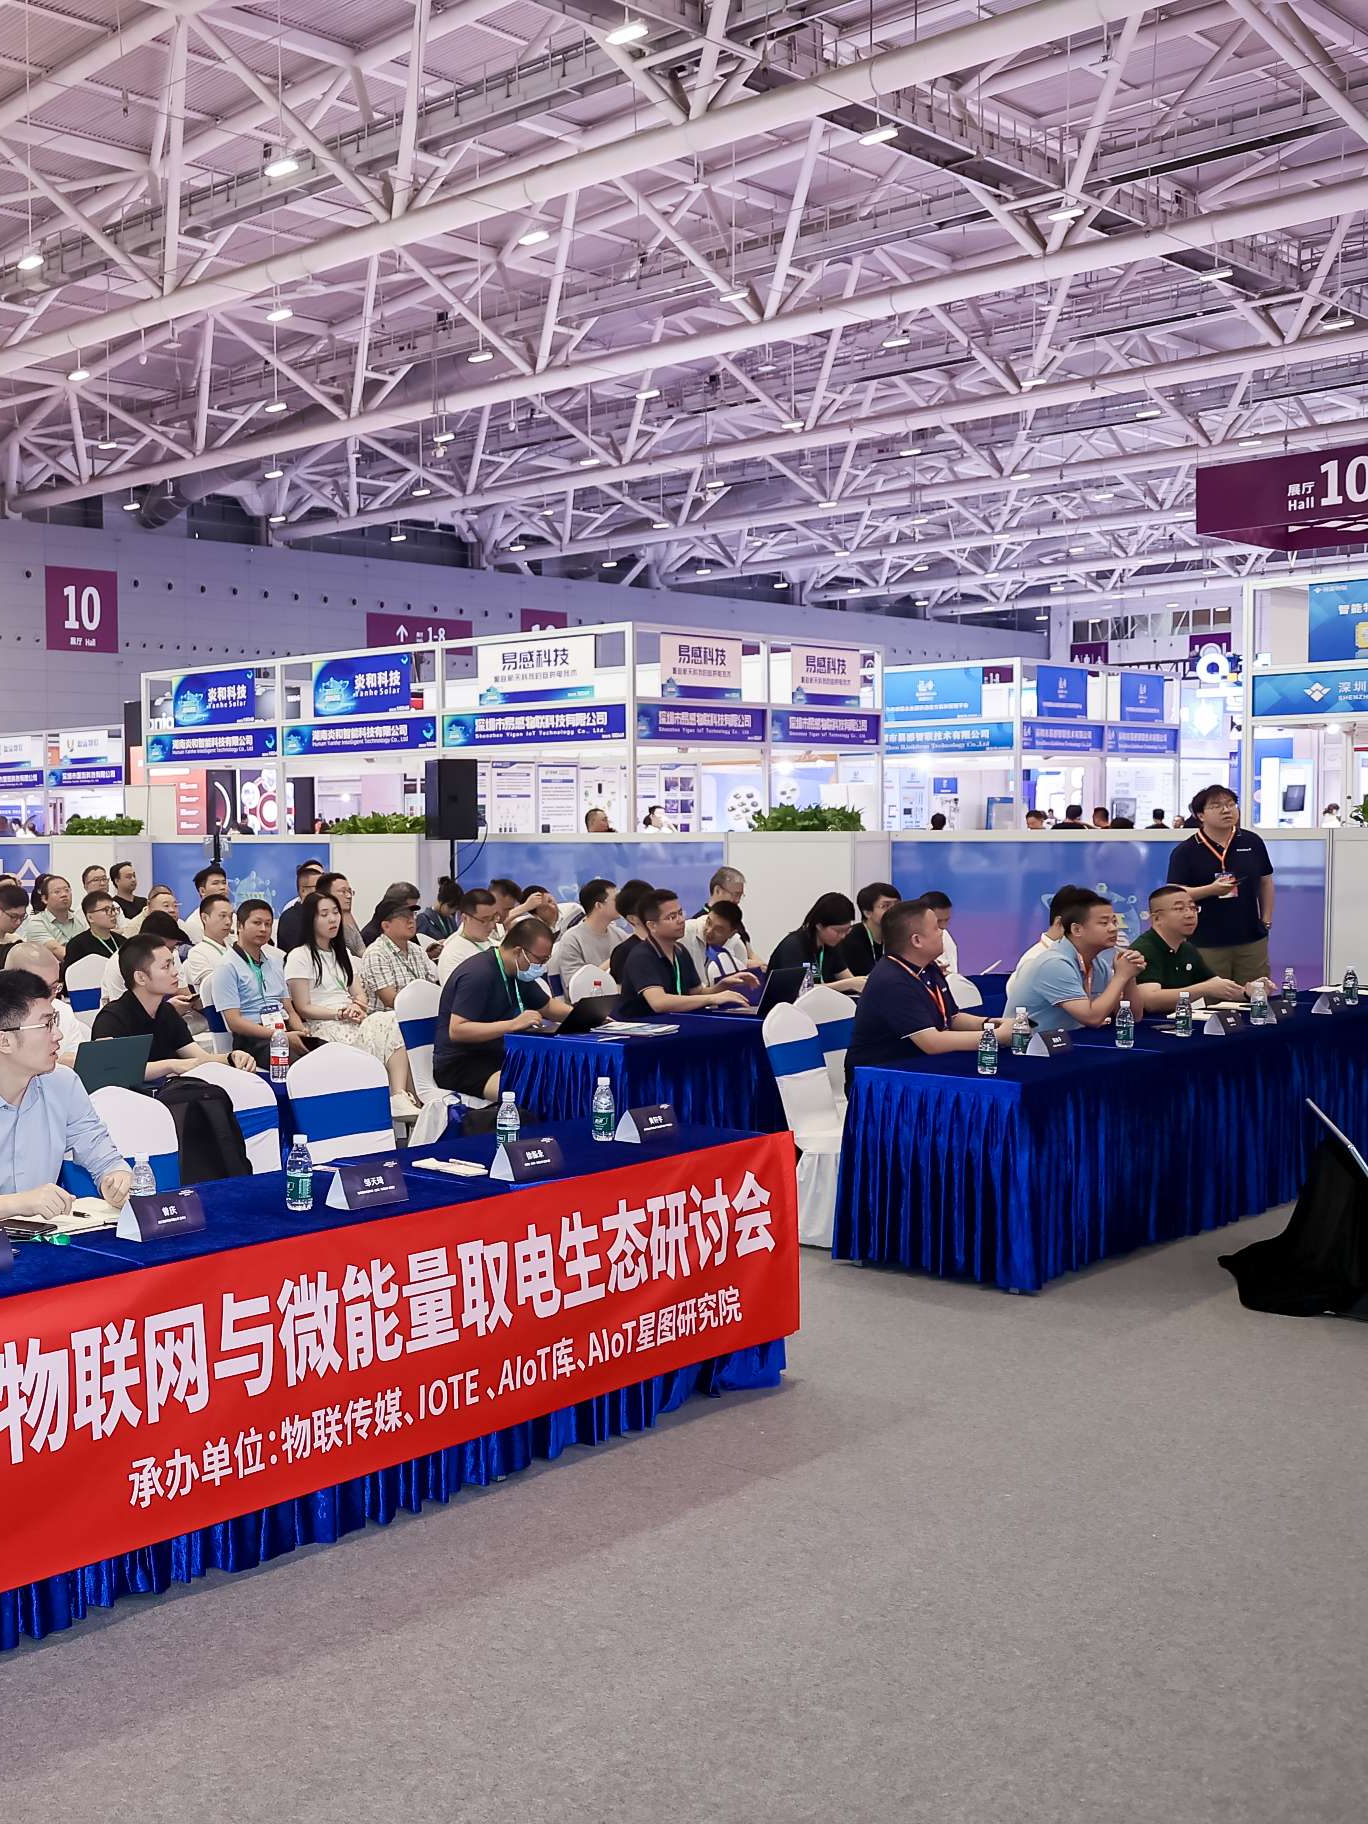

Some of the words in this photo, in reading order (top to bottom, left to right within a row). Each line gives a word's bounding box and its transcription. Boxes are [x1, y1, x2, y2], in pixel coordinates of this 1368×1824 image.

[1287, 481, 1315, 498] 展厅
[1319, 455, 1368, 507] 10
[1288, 496, 1315, 512] Hall
[63, 585, 101, 631] 10
[502, 648, 569, 671] 易感科技
[678, 644, 726, 666] 易感科技
[806, 655, 847, 675] 易感科技
[354, 669, 400, 690] 炎和科技
[207, 684, 247, 702] 炎和科技
[379, 686, 401, 696] Solar
[228, 700, 247, 708] Solar
